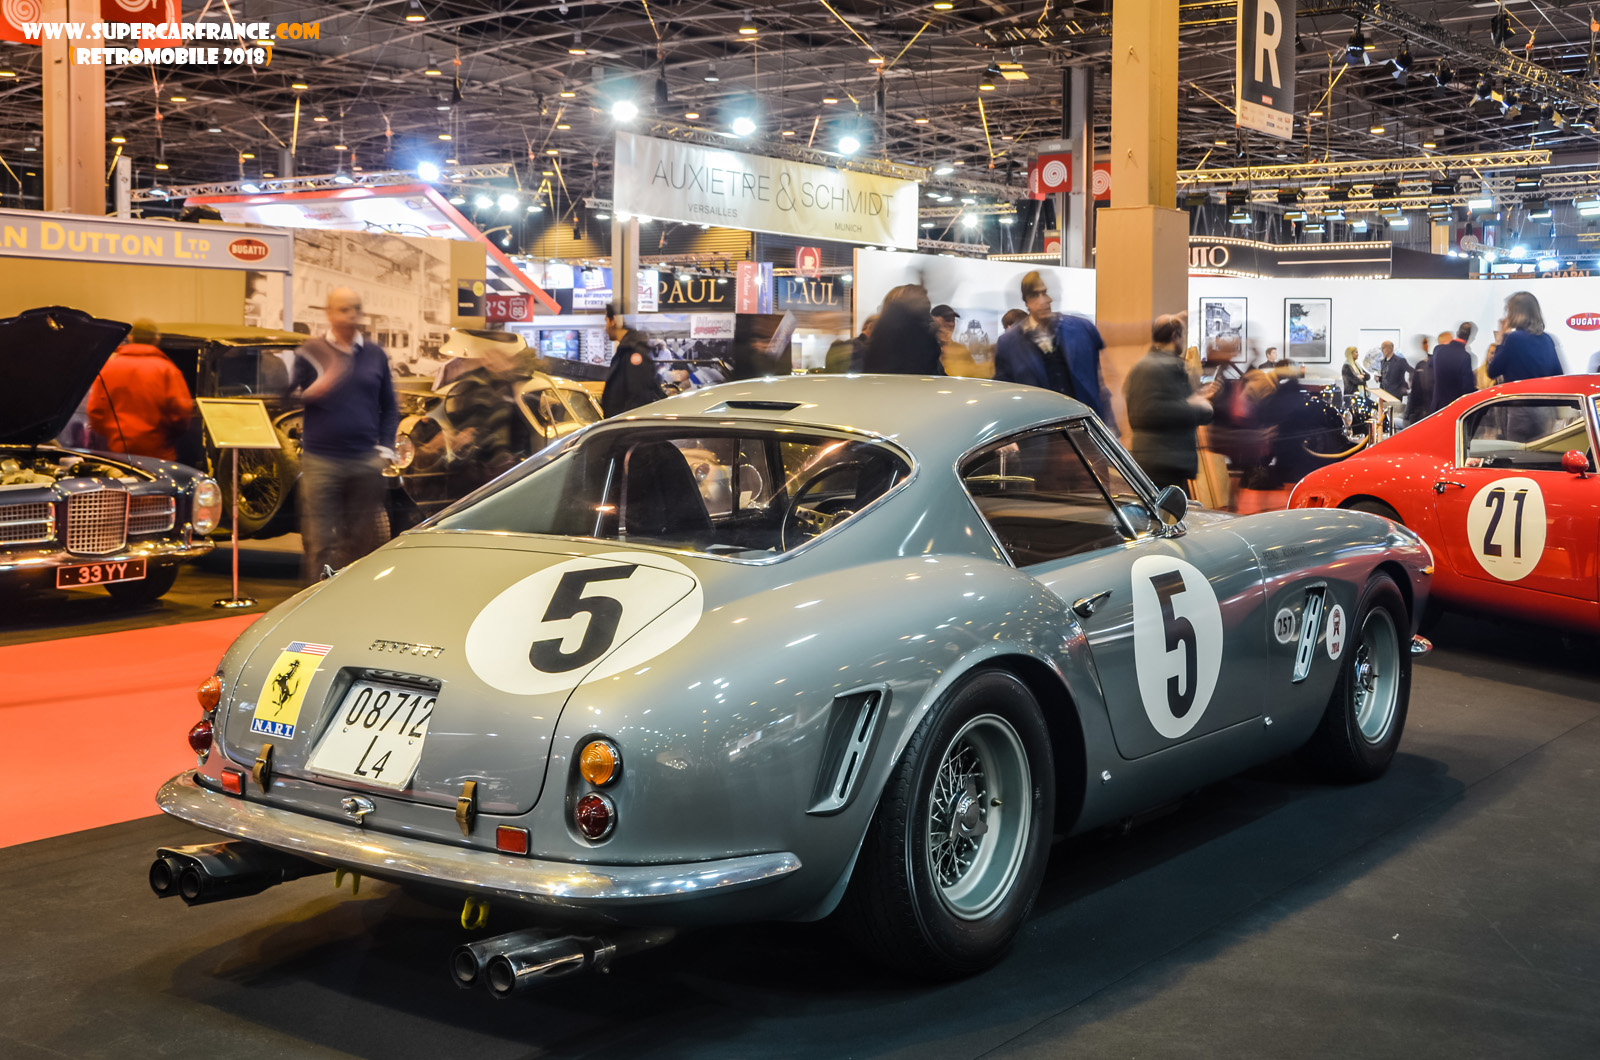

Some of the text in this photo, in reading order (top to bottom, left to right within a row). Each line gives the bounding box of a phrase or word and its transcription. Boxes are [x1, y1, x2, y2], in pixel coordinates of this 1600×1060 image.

[1254, 0, 1282, 89] R
[652, 159, 894, 218] AUXIETRE & SCHMIDT
[688, 203, 738, 218] VERSAILLES
[834, 222, 863, 233] MUNICH
[231, 244, 266, 256] BUGATTI
[658, 279, 724, 304] PAUL
[786, 280, 838, 306] PAUL
[1483, 487, 1528, 558] 21
[78, 562, 128, 583] 33 YY
[529, 564, 639, 674] 5
[1277, 616, 1292, 637] 257
[1149, 569, 1197, 719] 5
[345, 687, 437, 738] 08712
[253, 719, 292, 737] NART
